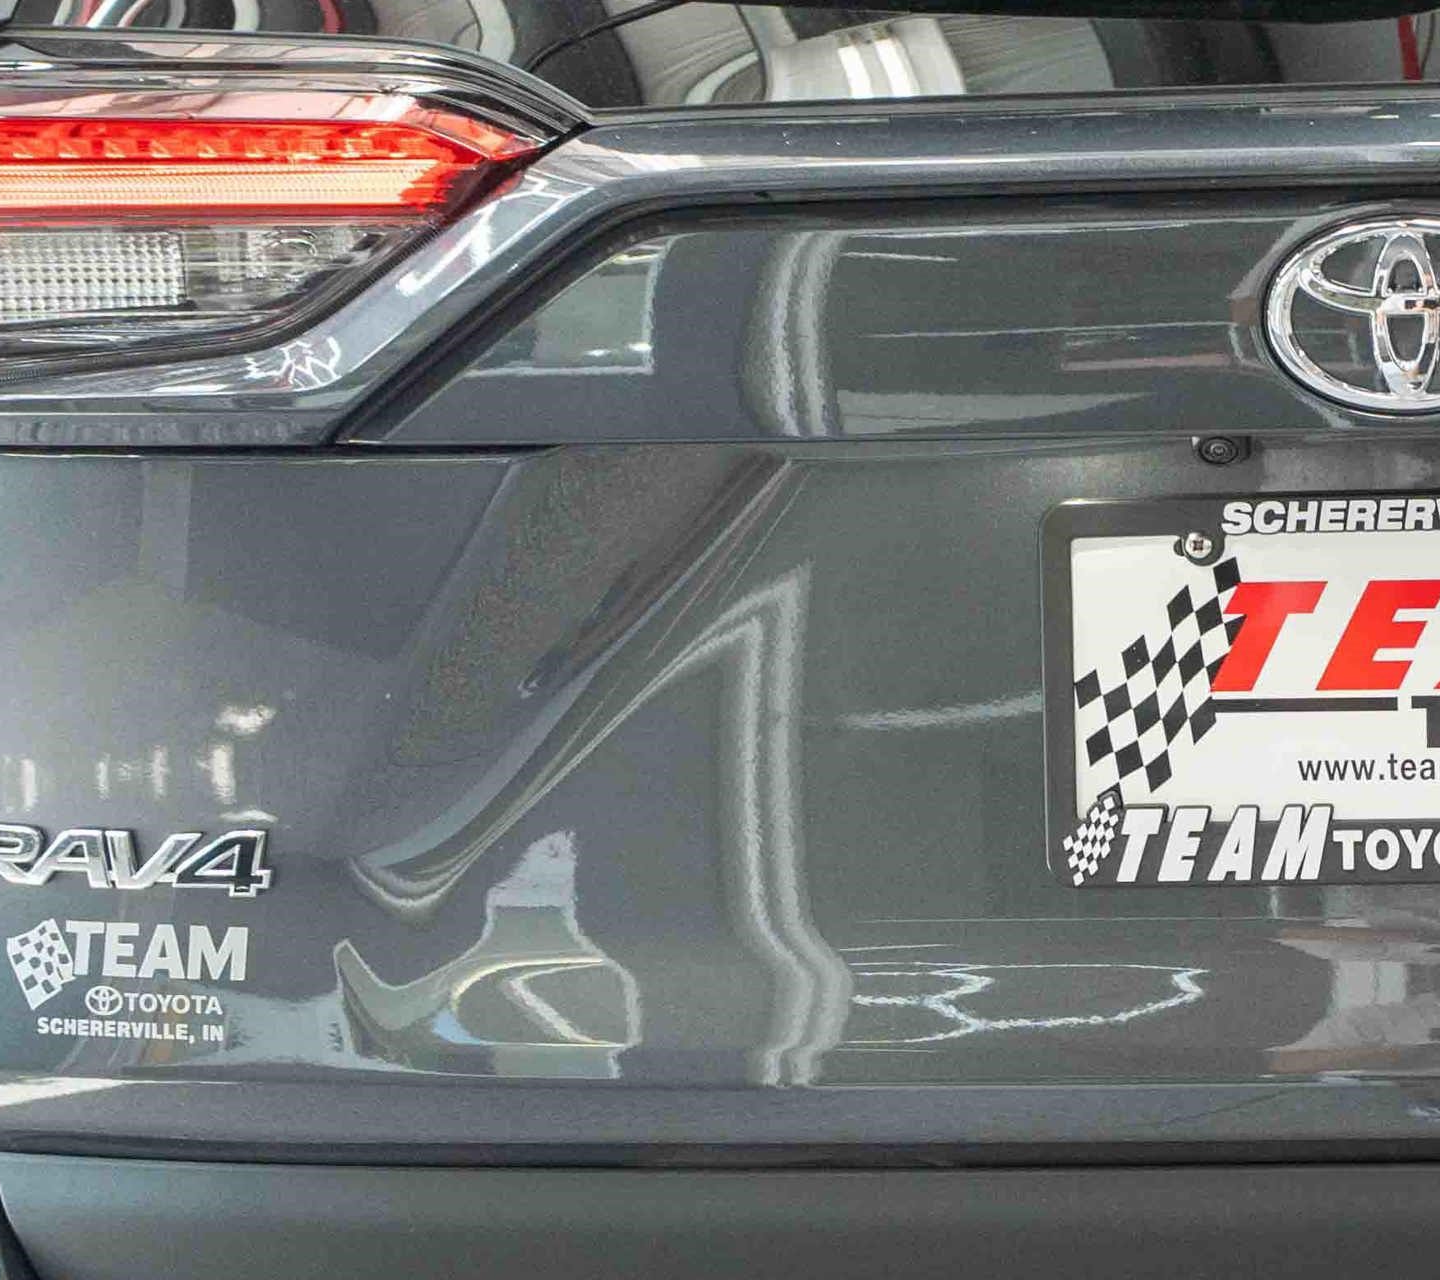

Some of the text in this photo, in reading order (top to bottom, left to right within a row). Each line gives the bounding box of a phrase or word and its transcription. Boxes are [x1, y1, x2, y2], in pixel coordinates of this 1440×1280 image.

[65, 920, 249, 981] TEAM
[123, 991, 224, 1016] TOYOTA
[36, 1017, 225, 1044] SCHERERVILLE, IN
